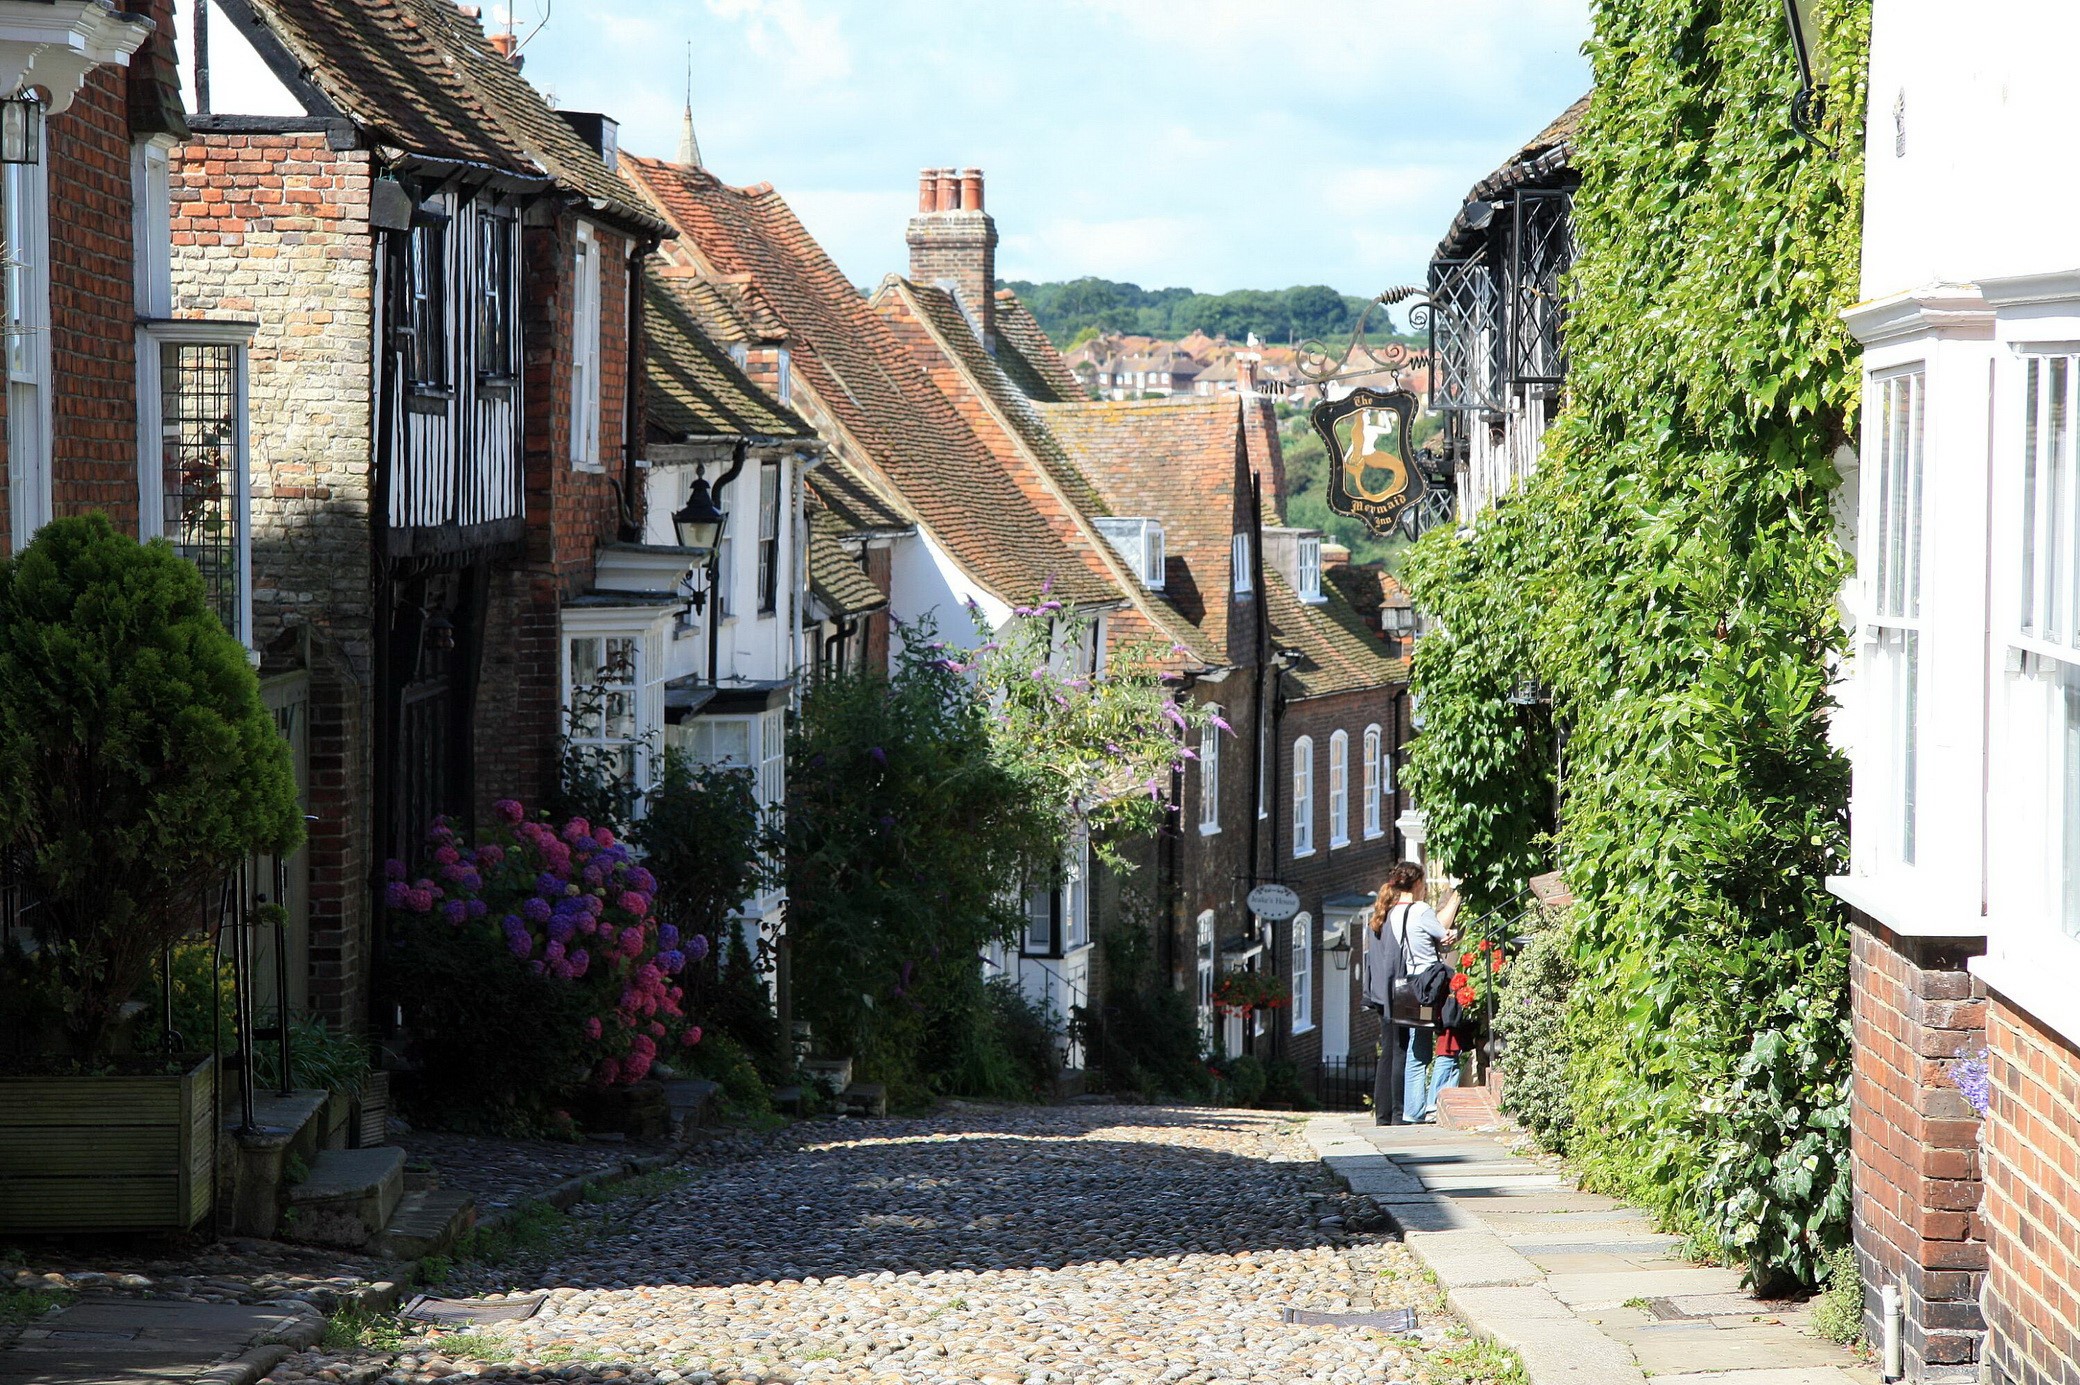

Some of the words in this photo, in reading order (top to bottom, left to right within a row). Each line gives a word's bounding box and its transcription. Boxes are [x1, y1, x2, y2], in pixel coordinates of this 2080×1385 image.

[1354, 396, 1373, 407] The
[1351, 495, 1407, 514] Mermaid
[1374, 516, 1392, 529] Inn
[1275, 896, 1296, 906] House
